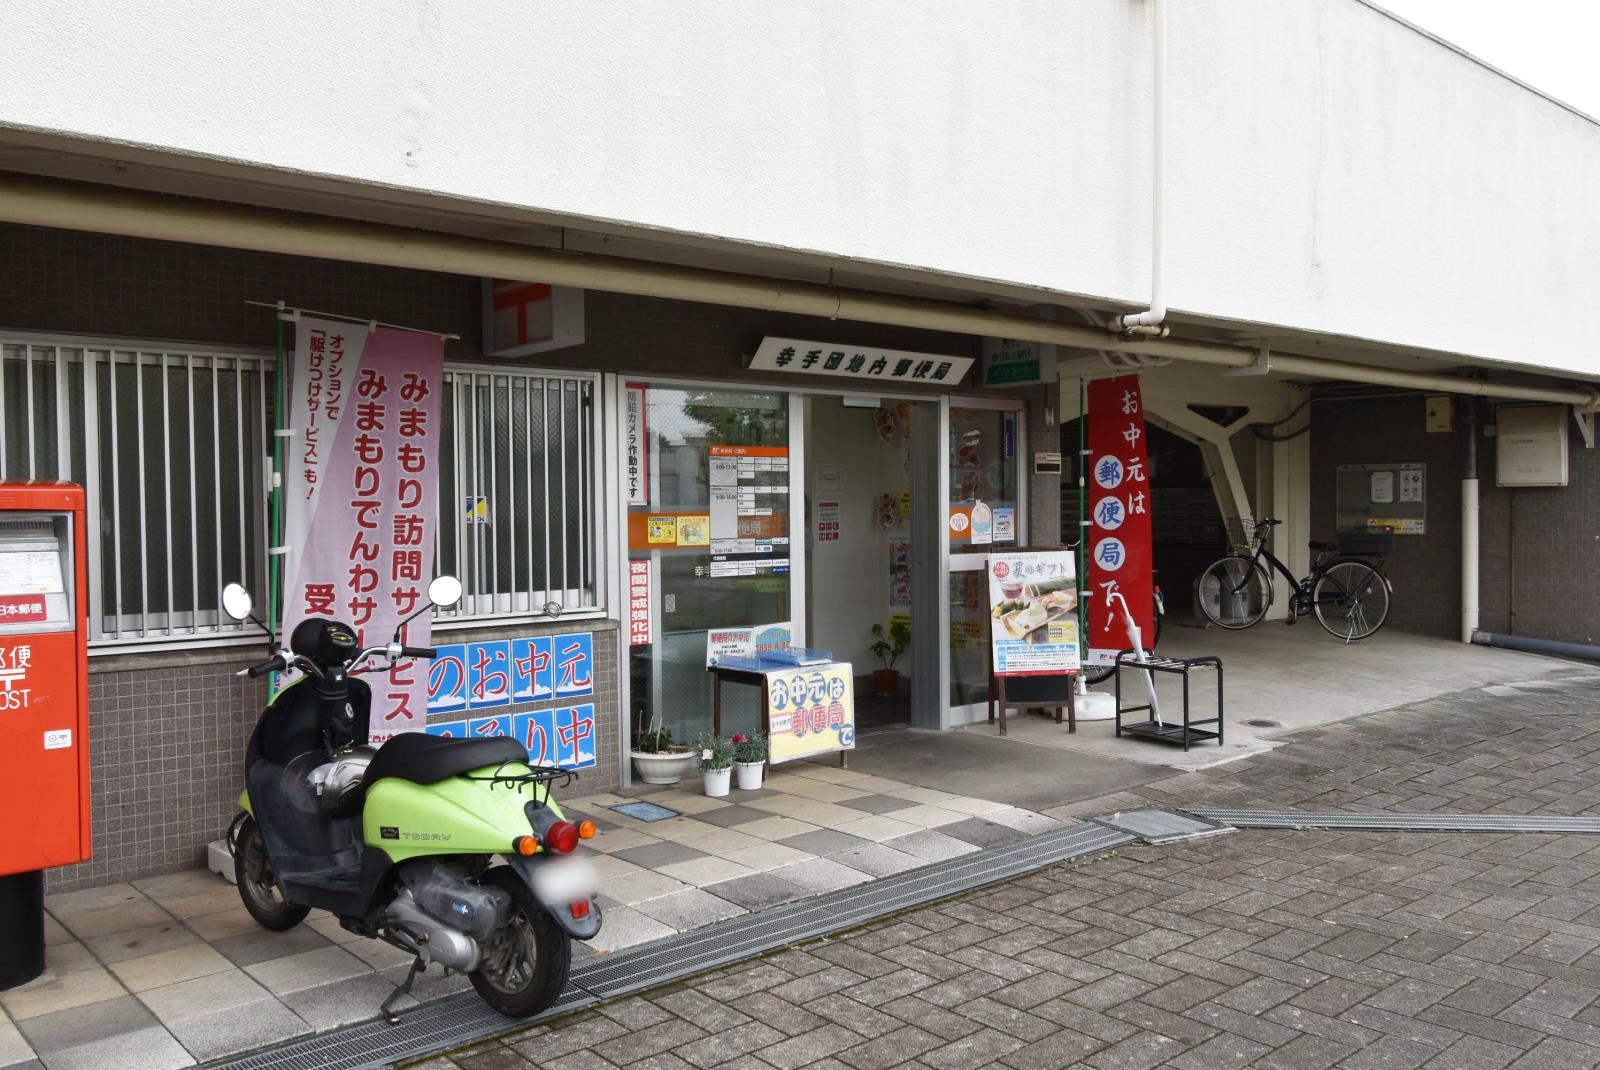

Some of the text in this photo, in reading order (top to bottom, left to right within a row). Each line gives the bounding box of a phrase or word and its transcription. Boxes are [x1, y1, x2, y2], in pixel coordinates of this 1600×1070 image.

[325, 335, 344, 421] オプションで
[776, 347, 952, 381] 幸手団地内郵便局
[304, 329, 327, 500] 「駆けつけサービス」も！
[627, 391, 638, 498] 防犯カメラ作動中です
[1121, 390, 1146, 515] お中元は
[384, 373, 430, 721] みまもり訪問サービス
[0, 689, 31, 710] OST
[771, 672, 844, 709] お中元は
[791, 703, 845, 734] 郵便局
[402, 832, 452, 841] TODAY
